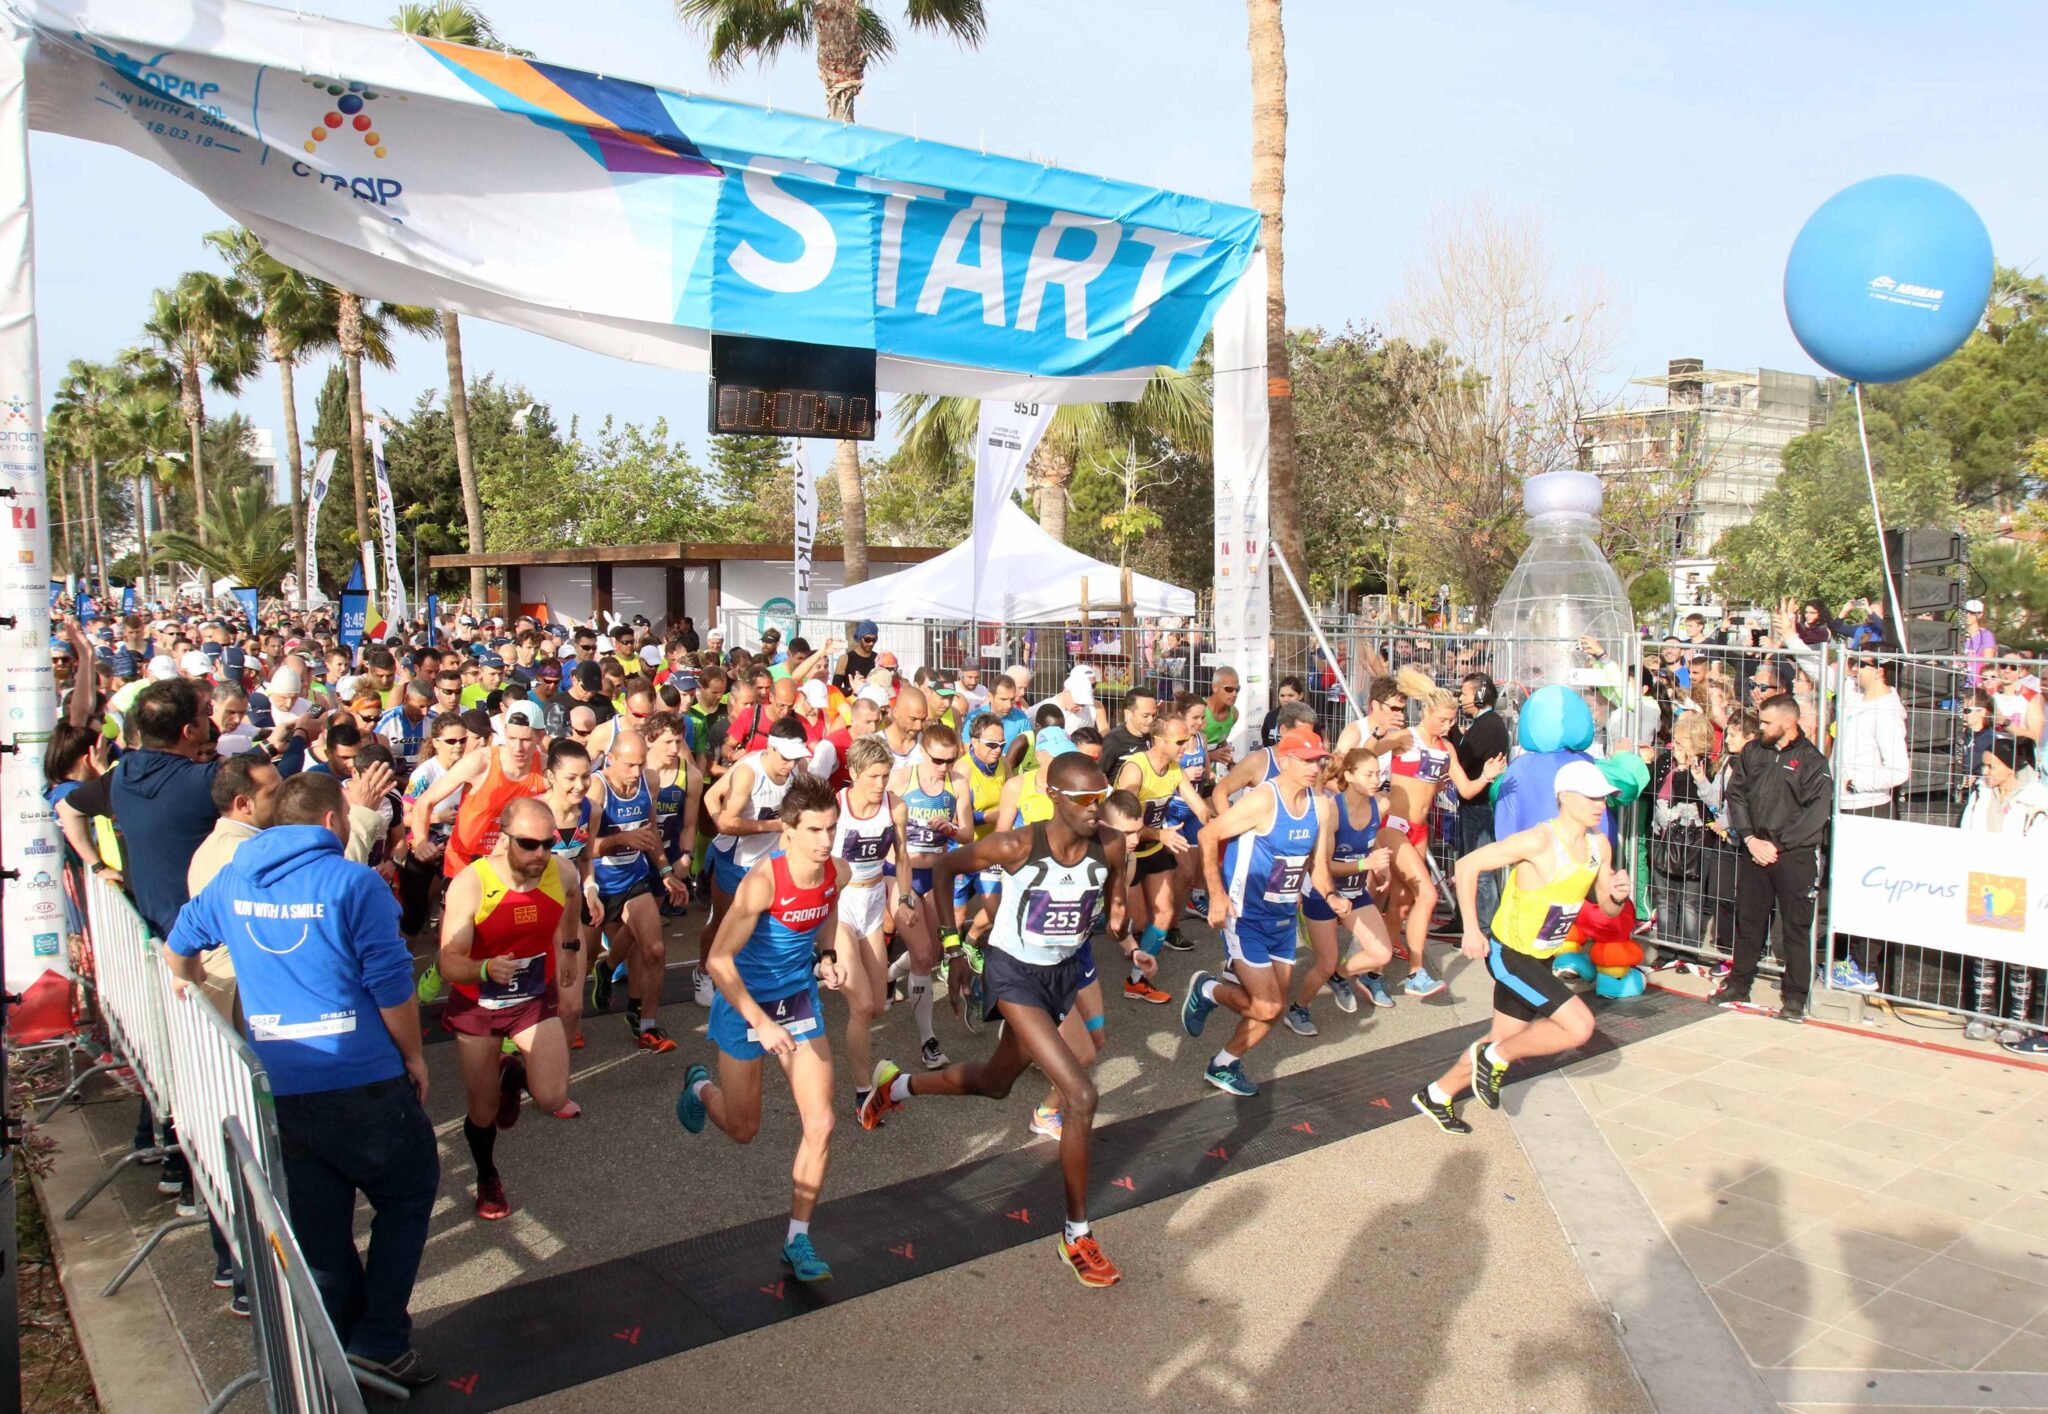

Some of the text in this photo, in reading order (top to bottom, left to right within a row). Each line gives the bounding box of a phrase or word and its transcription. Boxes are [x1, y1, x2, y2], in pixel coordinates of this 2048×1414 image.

[143, 72, 220, 99] OPAP
[137, 95, 181, 117] WITH
[183, 110, 195, 121] A
[727, 155, 1215, 341] START
[1895, 283, 1945, 299] AEGEAN
[718, 388, 869, 433] 00:00:00
[344, 611, 365, 628] 3:45
[1430, 764, 1442, 777] 14
[909, 807, 951, 820] UKRAINE
[919, 829, 934, 842] 13
[861, 844, 877, 857] 16
[27, 880, 58, 889] CHOICE
[1284, 874, 1300, 888] 27
[1347, 876, 1360, 887] 11
[1861, 865, 1960, 904] Cyprus
[253, 901, 279, 918] WITH
[280, 904, 289, 919] A
[290, 903, 325, 918] SMILE
[781, 903, 830, 923] CROATIA
[1043, 911, 1081, 928] 253
[1554, 921, 1573, 934] 21
[508, 977, 519, 992] 5
[776, 999, 787, 1017] 4
